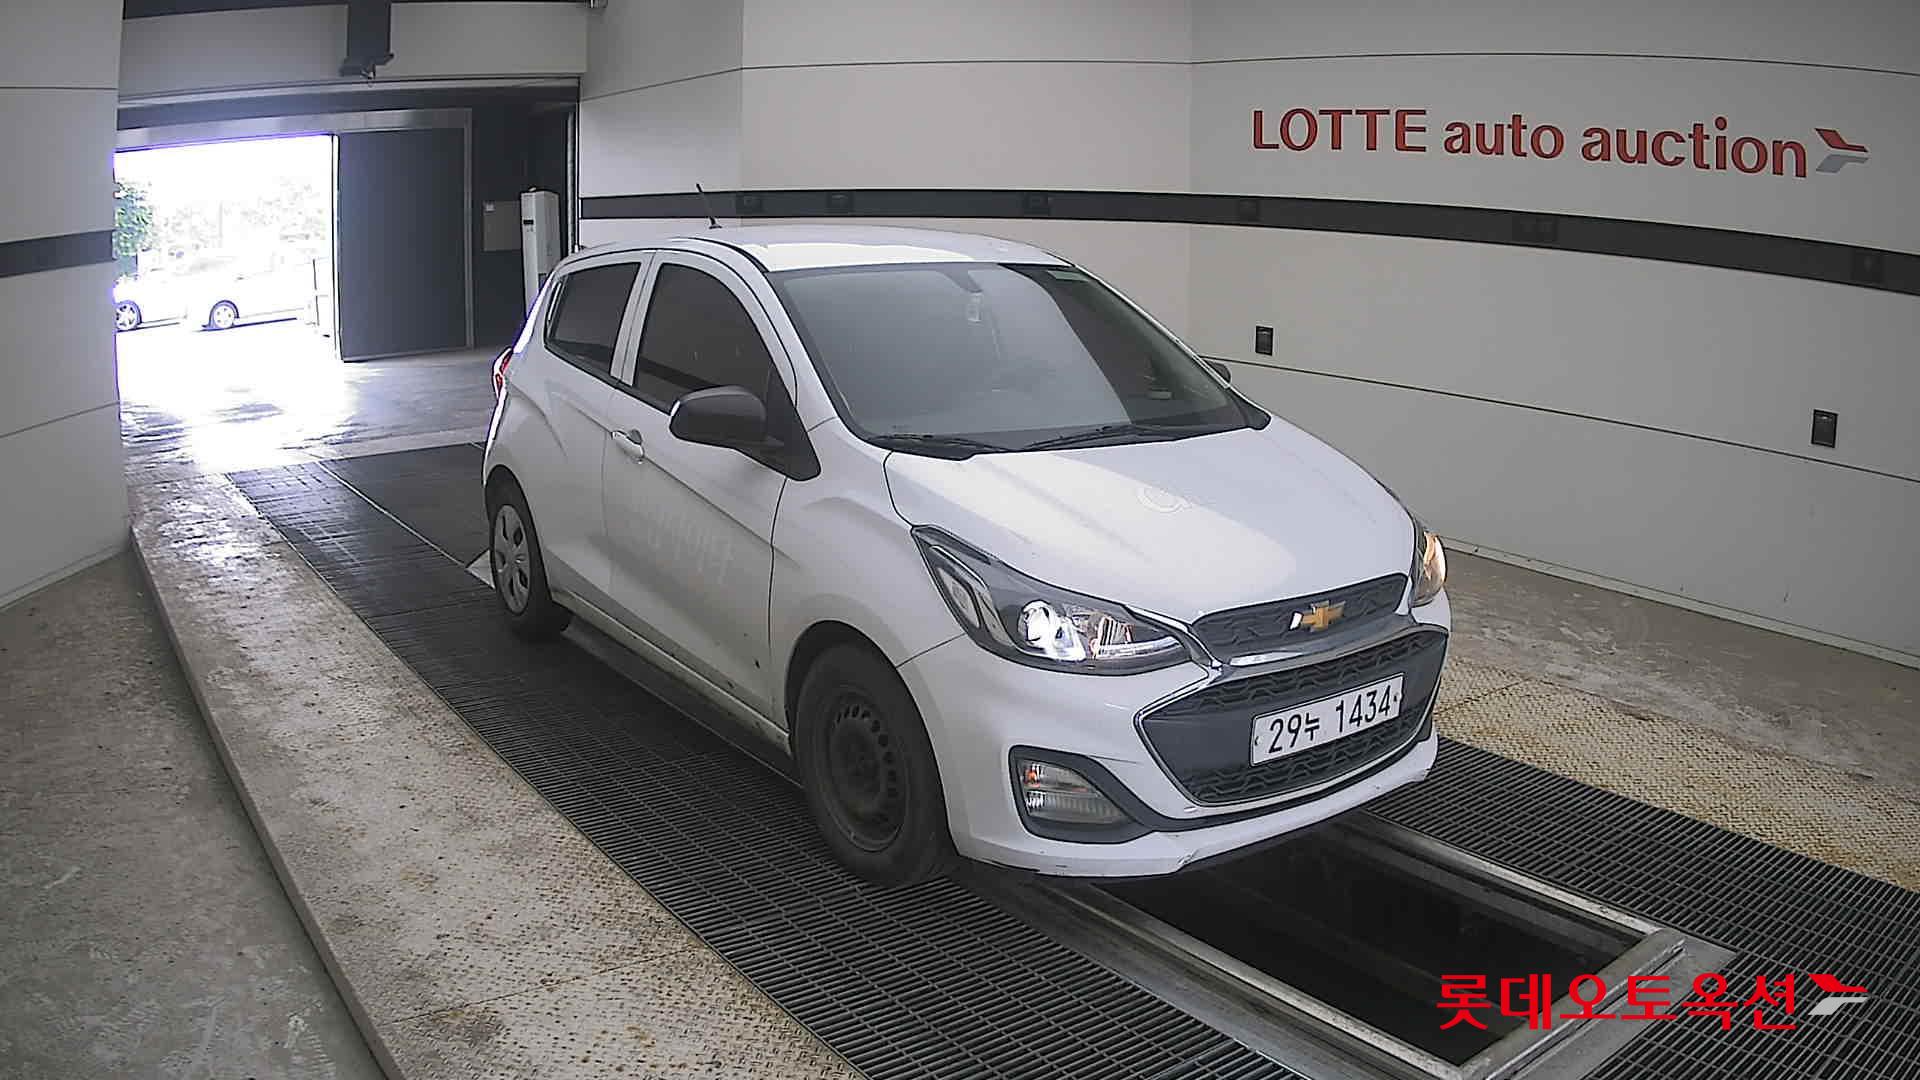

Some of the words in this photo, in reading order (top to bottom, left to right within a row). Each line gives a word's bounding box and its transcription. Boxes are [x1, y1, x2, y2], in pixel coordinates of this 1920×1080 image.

[1253, 109, 1427, 152] LOTTE
[1444, 114, 1565, 158] auto
[1582, 117, 1806, 177] auction
[1268, 712, 1321, 754] 29누
[1336, 685, 1393, 734] 1434
